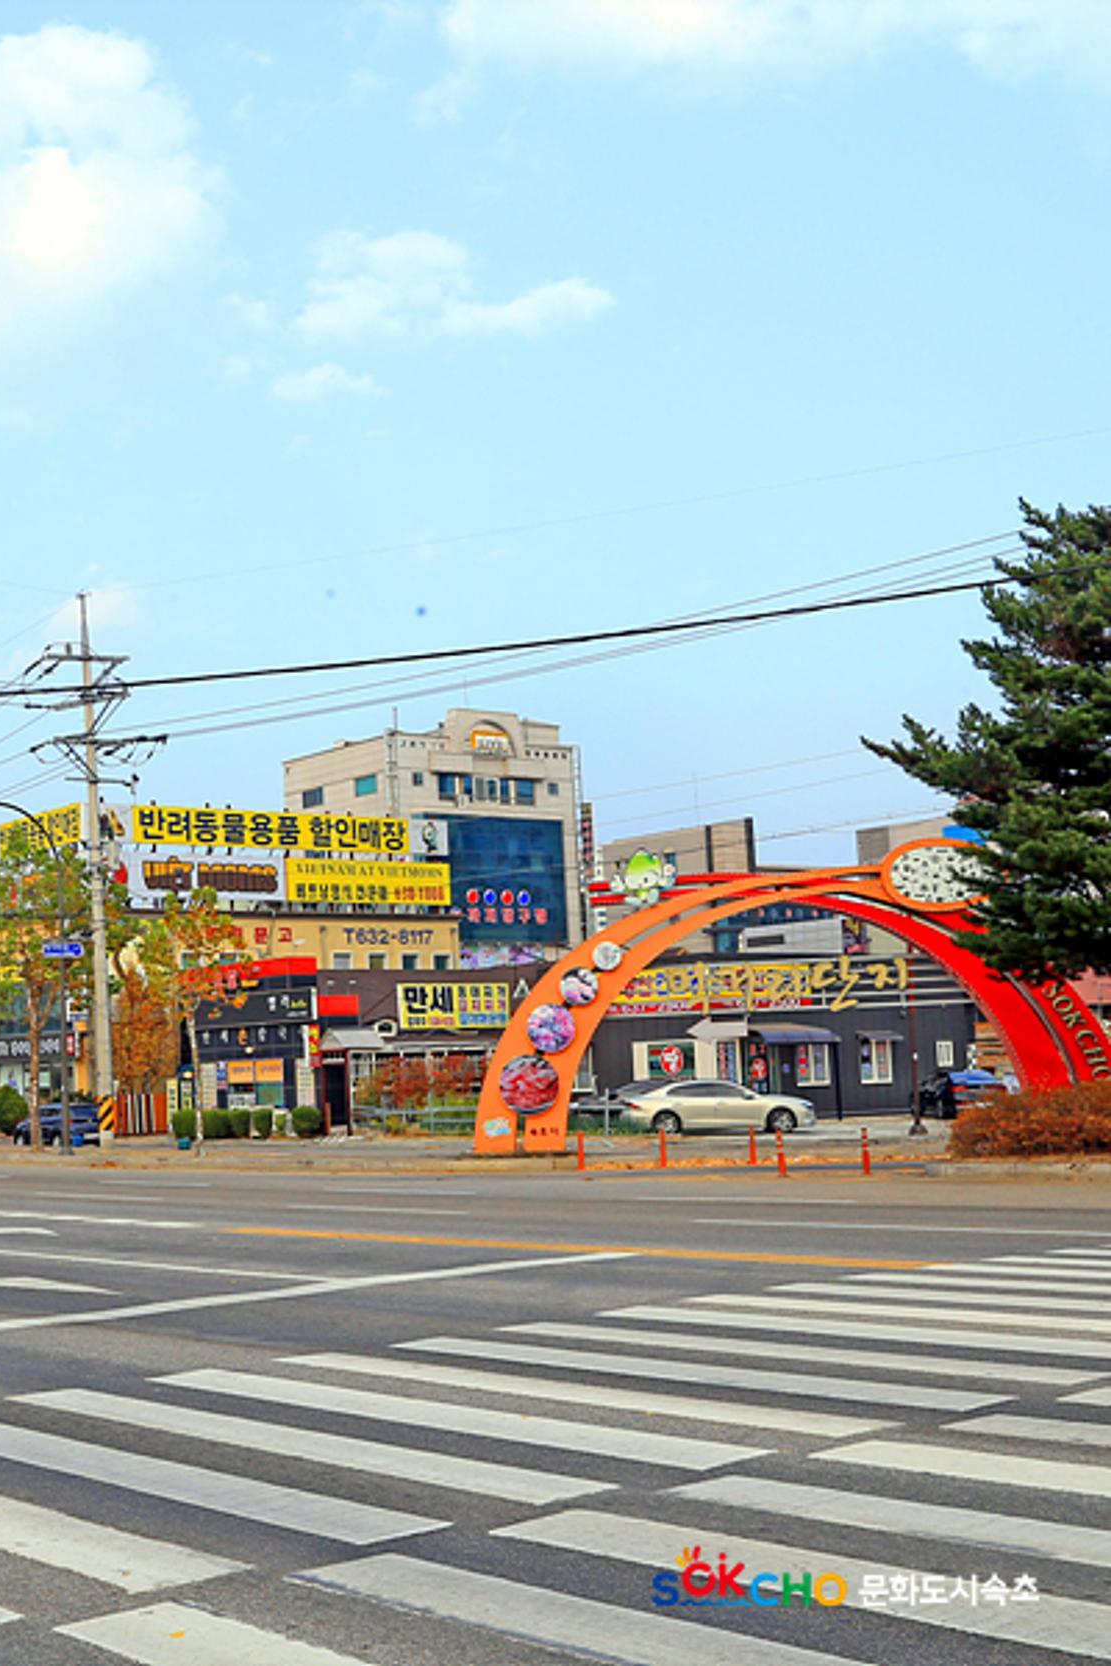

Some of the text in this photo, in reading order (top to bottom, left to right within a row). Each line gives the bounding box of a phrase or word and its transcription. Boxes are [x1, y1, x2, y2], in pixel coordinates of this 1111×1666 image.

[139, 809, 405, 850] 반려동물용품 할인매장
[404, 986, 453, 1014] 만세
